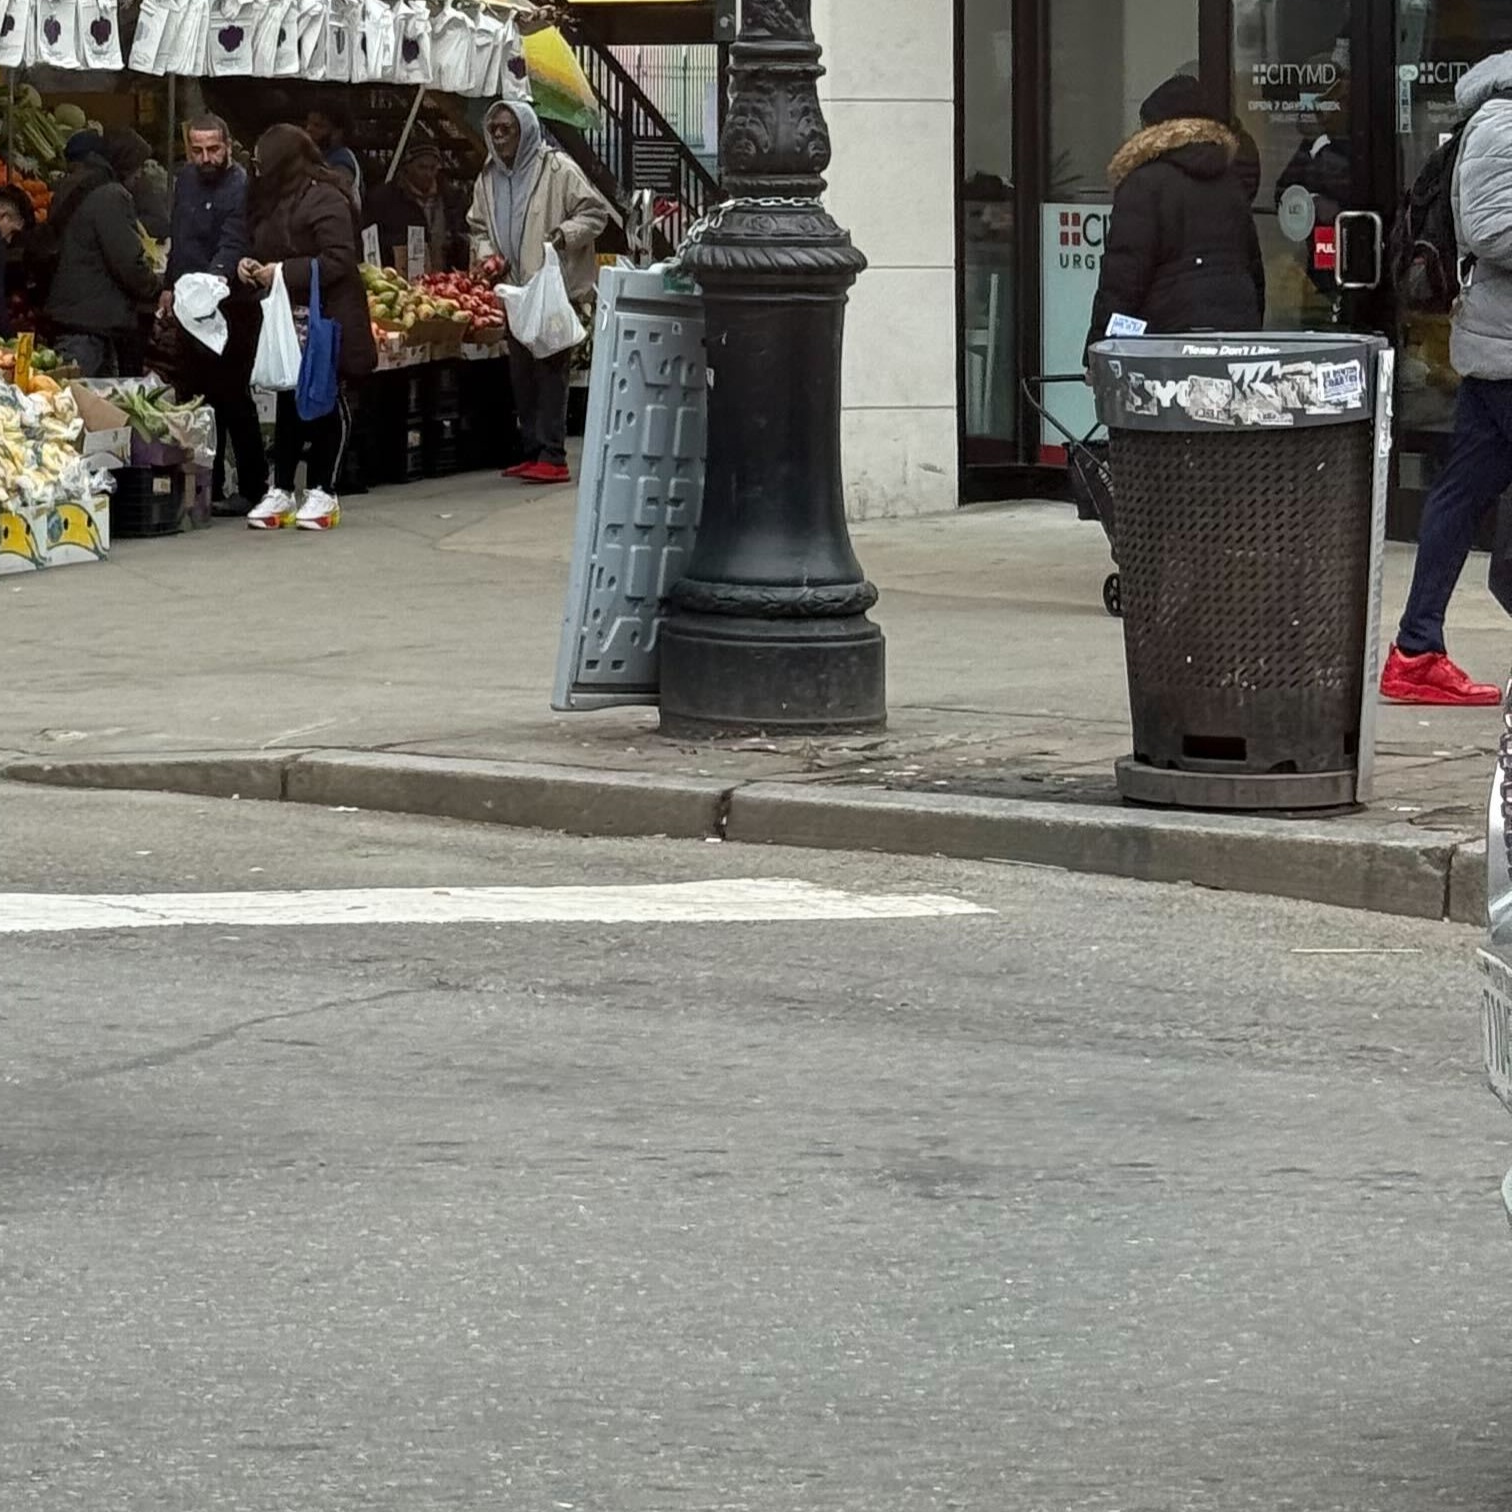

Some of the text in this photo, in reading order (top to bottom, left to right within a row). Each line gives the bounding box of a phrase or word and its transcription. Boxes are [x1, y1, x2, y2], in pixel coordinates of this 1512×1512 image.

[1266, 63, 1337, 85] CITYMD
[1434, 61, 1470, 83] CIT
[1316, 242, 1337, 254] PUL
[1059, 253, 1103, 270] URG
[1219, 346, 1250, 356] Don't
